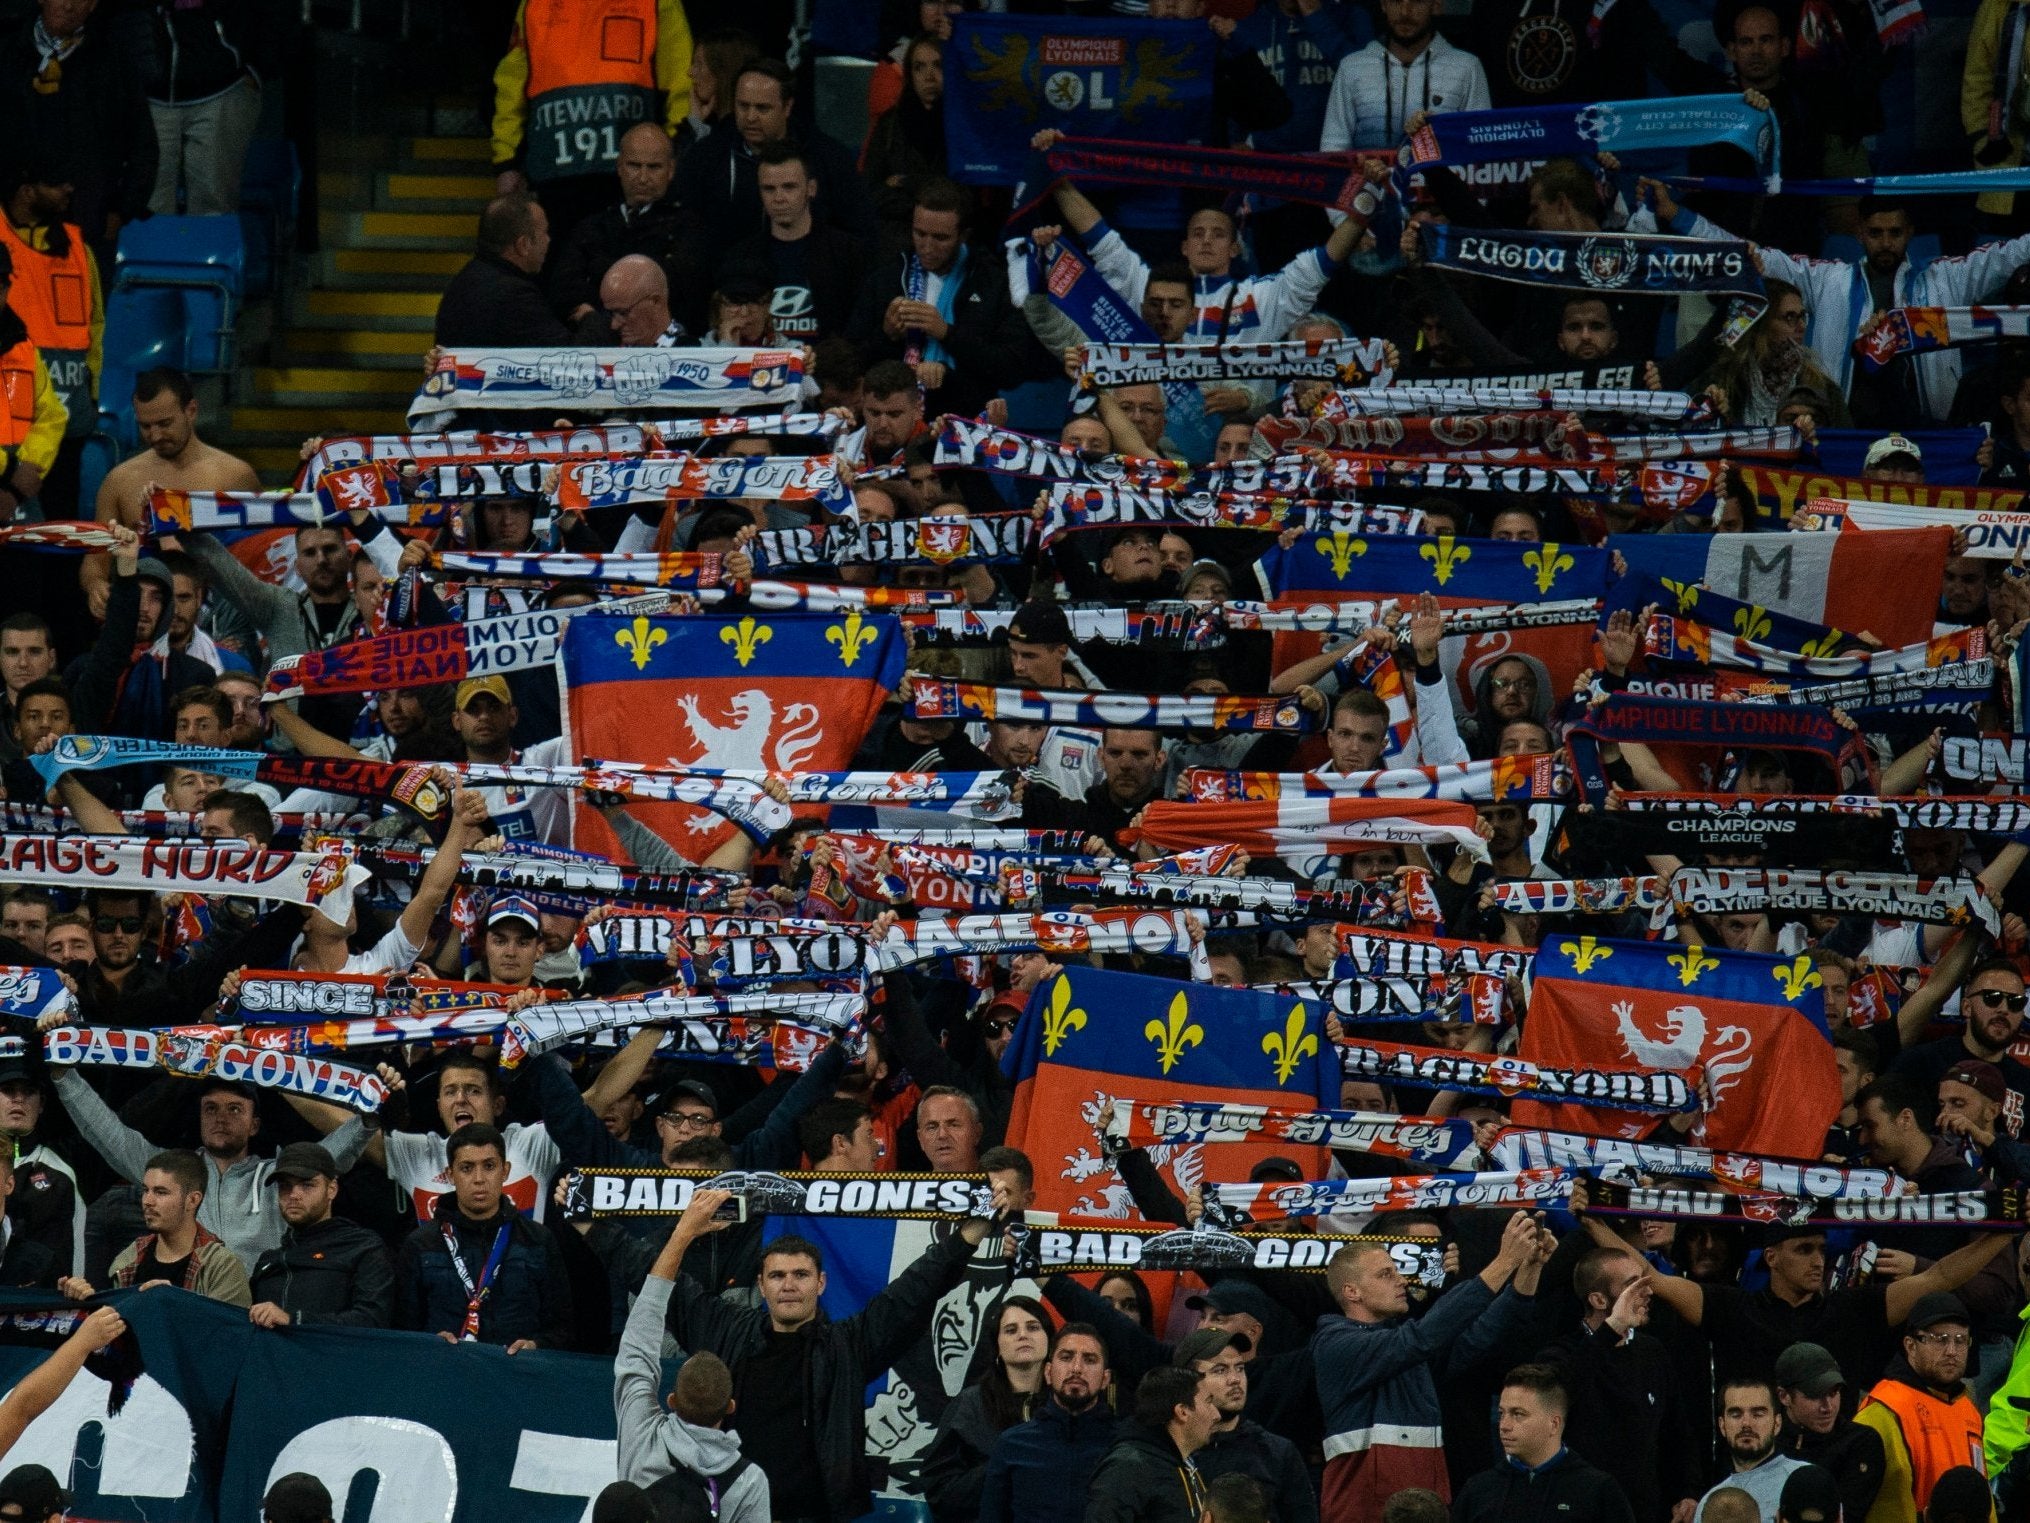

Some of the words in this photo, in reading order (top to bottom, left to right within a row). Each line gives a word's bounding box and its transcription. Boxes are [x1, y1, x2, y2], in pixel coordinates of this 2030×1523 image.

[1045, 50, 1120, 63] LYONNAIS
[1046, 38, 1120, 51] OLYMPIQUE
[534, 94, 645, 133] STEWARD
[554, 125, 620, 166] 191
[494, 364, 533, 381] SINCE
[676, 362, 715, 382] 1950
[1094, 362, 1222, 387] OLYMPIQUE
[1226, 360, 1337, 382] LYONNAIS
[438, 464, 556, 498] LYO
[570, 459, 686, 498] Bad
[1424, 461, 1600, 497] LYON
[995, 689, 1216, 727] LYON
[1279, 762, 1495, 802] LYON
[1666, 818, 1798, 835] CHAMPIONS
[1699, 833, 1765, 845] LEAGUE
[1694, 894, 1826, 915] OLYMPIQUE
[1830, 895, 1948, 921] LYONNAIS
[731, 933, 863, 976] LYO
[240, 979, 375, 1014] SINCE
[346, 1008, 508, 1045] LYO
[47, 1025, 160, 1068] BAD
[219, 1042, 386, 1113] GONES
[1537, 1069, 1688, 1110] NORD
[593, 1177, 697, 1213] BAD
[804, 1177, 974, 1214] GONES
[1761, 1155, 1903, 1200] NOR
[1833, 1189, 1988, 1222] GONES
[1039, 1232, 1144, 1267] BAD
[1253, 1238, 1423, 1277] GOS
